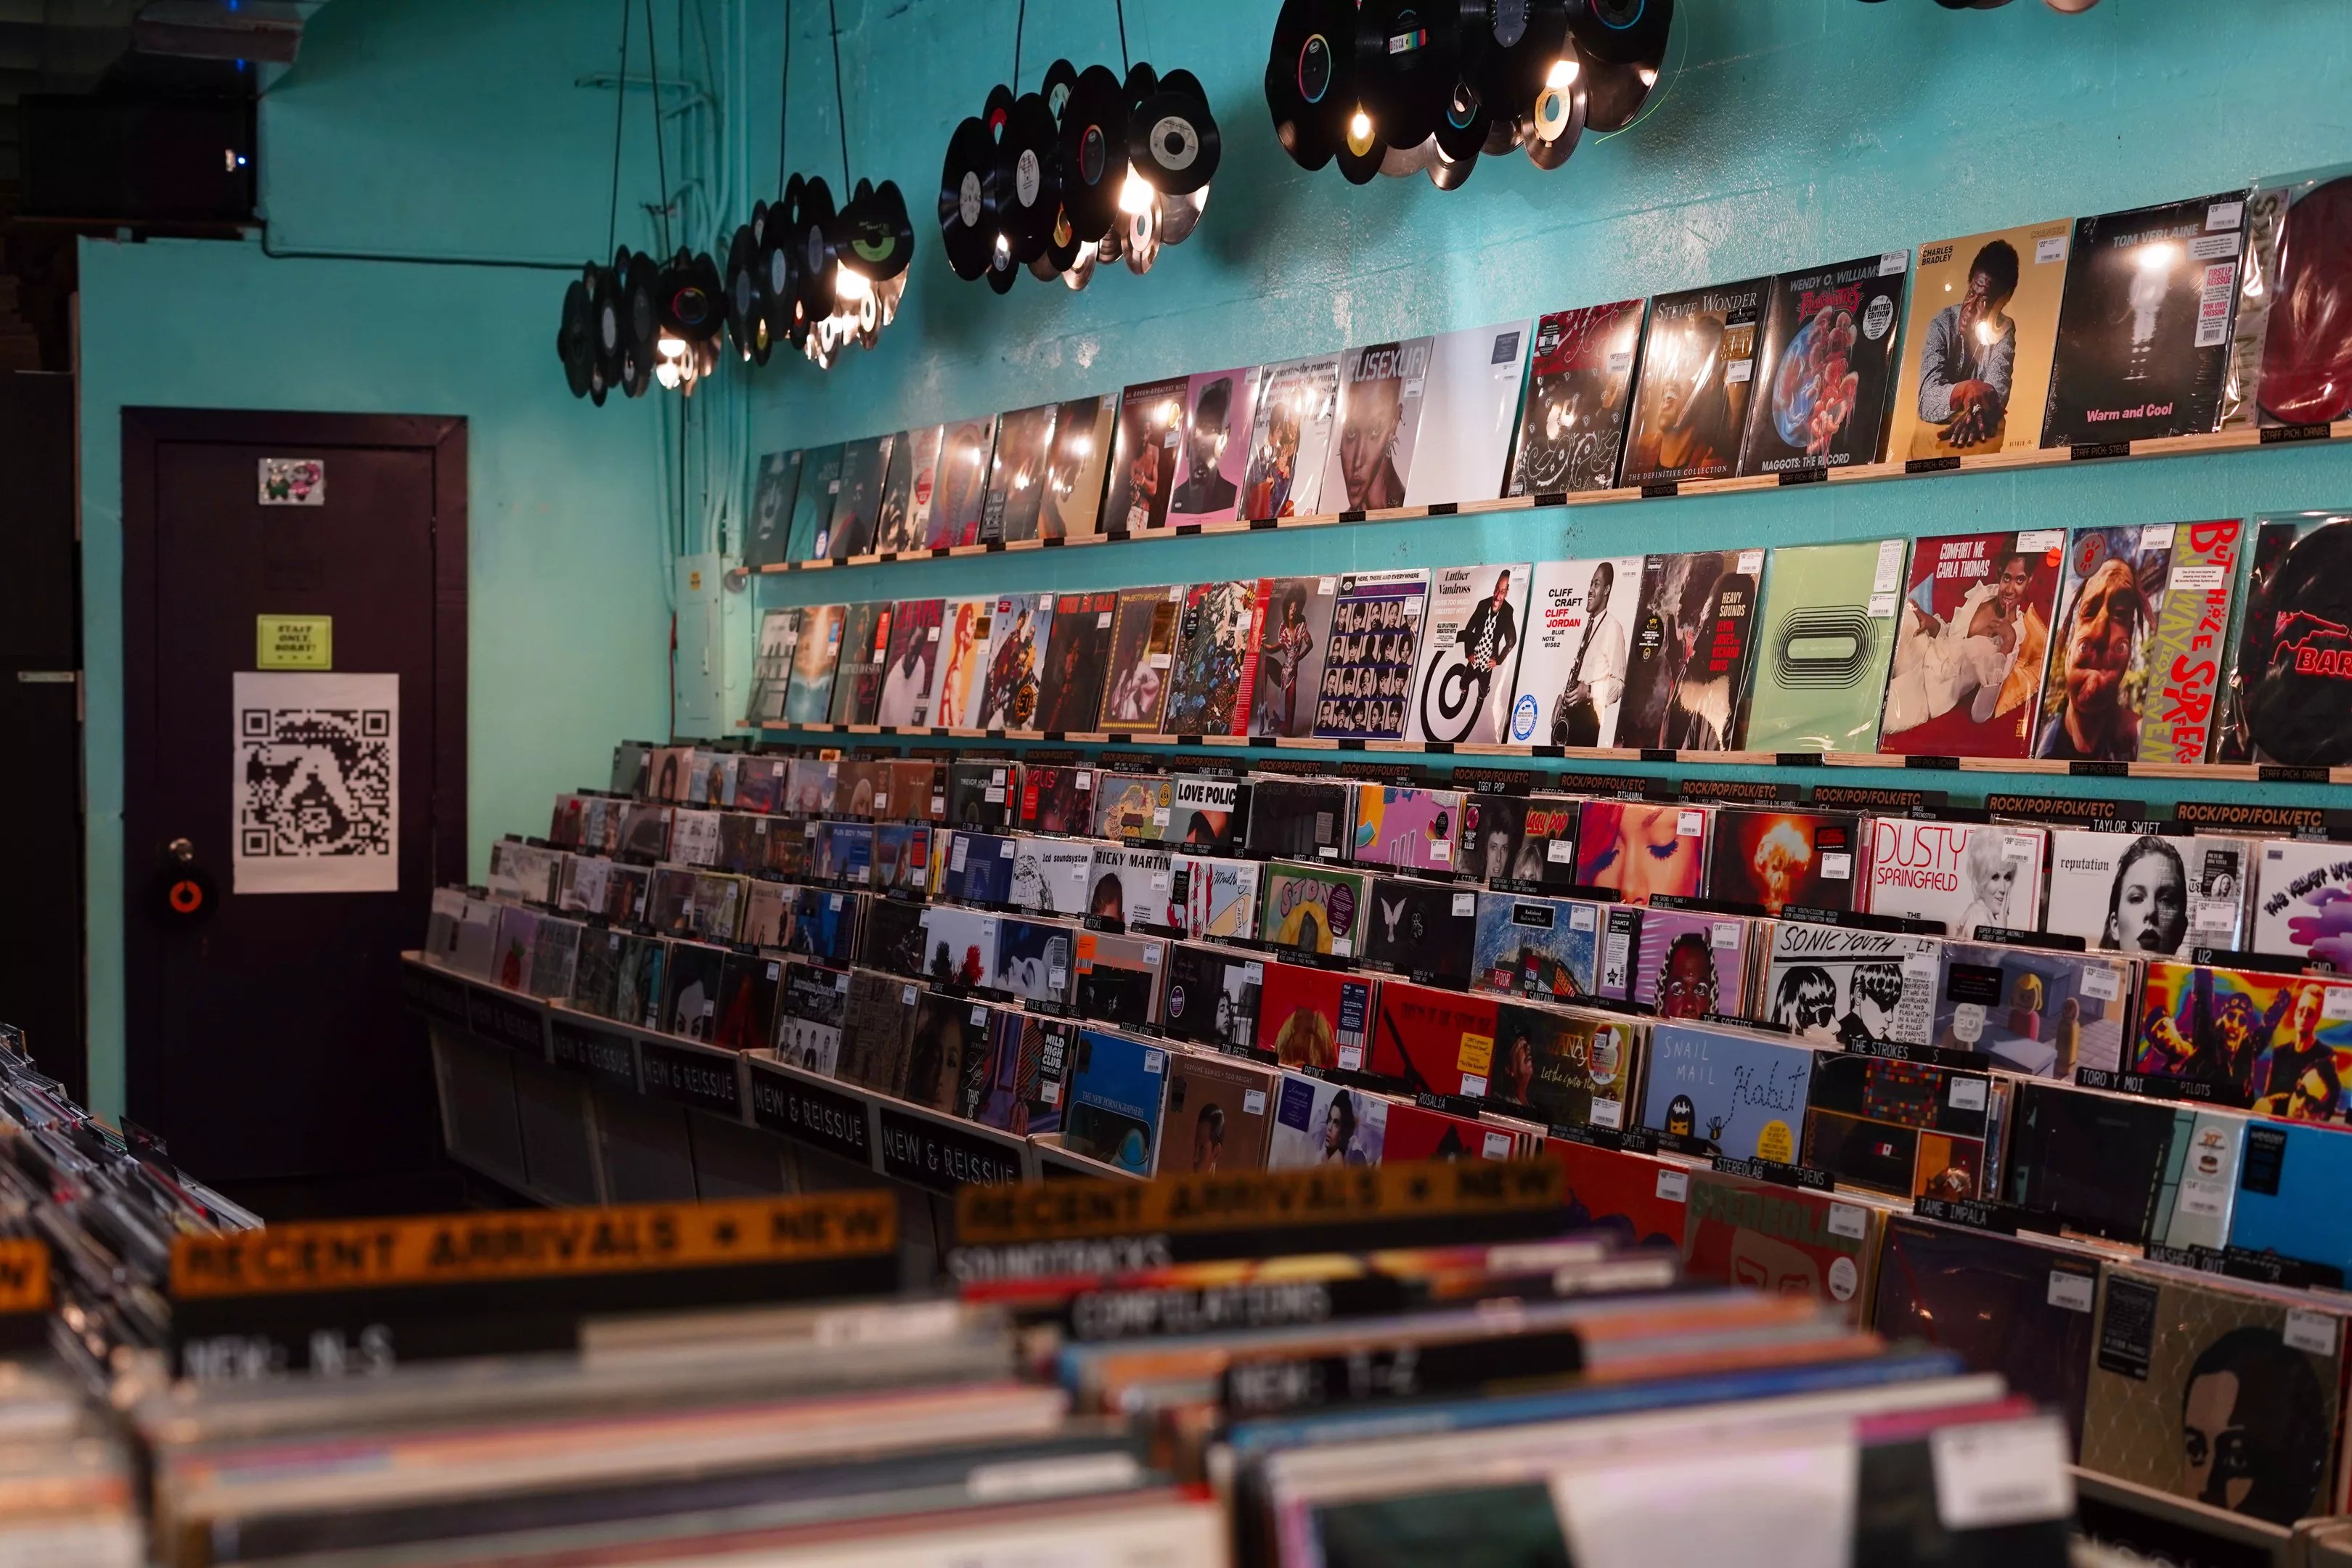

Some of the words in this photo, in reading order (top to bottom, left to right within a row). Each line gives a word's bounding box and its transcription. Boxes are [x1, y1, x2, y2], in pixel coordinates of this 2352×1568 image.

[1390, 38, 1405, 52] DECCA
[2113, 234, 2139, 248] TOM
[1923, 245, 1953, 258] CHARLES
[1922, 253, 1953, 266] BRADLEY
[1790, 275, 1822, 292] WENDY
[1824, 275, 1833, 285] O.
[1837, 264, 1881, 283] WILLIAMS
[2208, 268, 2225, 279] FIRST
[2225, 266, 2233, 277] LP
[2207, 275, 2231, 287] REISSUE
[1657, 302, 1697, 322] STEVIE
[1702, 293, 1757, 314] WONDER
[1867, 310, 1890, 319] EDITION
[1869, 302, 1890, 312] LIMITED
[2203, 308, 2226, 318] PRESSING
[2086, 408, 2120, 422] Warm
[2122, 404, 2143, 420] and
[2146, 402, 2173, 417] Cool
[2262, 430, 2282, 441] STAFF
[2283, 429, 2301, 438] PICK:
[2303, 426, 2329, 437] DANIEL
[2073, 448, 2089, 457] STAFF
[2091, 446, 2106, 456] PICK:
[2108, 444, 2128, 454] STEVE
[1762, 457, 1801, 472] MAGGOTS:
[1802, 456, 1816, 467] THE
[1906, 462, 1922, 473] STAFF
[1938, 457, 1959, 468] ROHAN
[1643, 469, 1681, 480] DEFINITIVE
[1683, 465, 1728, 477] COLLECTION
[1940, 542, 1972, 560] COMFORT
[1973, 542, 1986, 558] ME
[1445, 570, 1470, 581] Luther
[1936, 561, 1959, 579] CARLA
[1960, 560, 1990, 577] THOMAS
[1439, 582, 1471, 595] Vandross
[1548, 588, 1573, 597] CLIFF
[1555, 598, 1583, 608] CRAFT
[1722, 592, 1742, 604] HEAVY
[1545, 608, 1569, 618] CLIFF
[1719, 605, 1746, 617] SOUNDS
[1547, 618, 1580, 628] JORDAN
[1716, 621, 1735, 632] ELVIN
[1713, 633, 1734, 645] JONES
[1712, 647, 1740, 658] RICHARD
[1710, 660, 1729, 671] DAVIS
[1175, 756, 1231, 767] ROCK/POP/FOLK/ETC
[1259, 761, 1320, 772] ROCK/POP/FOLK/ETC
[1342, 763, 1410, 776] ROCK/POP/FOLK/ETC
[1453, 768, 1530, 783] ROCK/POP/FOLK/ETC
[2107, 766, 2127, 775] STEVE
[2261, 769, 2279, 777] STAFF
[2302, 770, 2329, 780] DANIEL
[1477, 781, 1491, 792] IGGY
[1493, 782, 1505, 793] POP
[1561, 775, 1646, 791] ROCK/POP/FOLK/ETC
[1682, 782, 1776, 799] ROCK/POP/FOLK/ETC
[1178, 783, 1204, 801] LOVE
[1617, 791, 1643, 801] RIHANNA
[1815, 788, 1922, 806] ROCK/POP/FOLK/ETC
[1989, 796, 2115, 817] ROCK/POP/FOLK/ETC
[2178, 804, 2323, 826] ROCK/POP/FOLK/ETC
[2093, 820, 2128, 833] TAYLOR
[2131, 821, 2160, 834] SWIFT
[1877, 823, 1966, 871] DUSTY
[1042, 854, 1052, 862] lcd
[1053, 854, 1087, 864] soundsystem
[1095, 851, 1125, 867] RICKY
[1129, 854, 1171, 871] MARTIN
[2059, 857, 2110, 872] reputation
[1877, 867, 1959, 891] SPRINGFIELD
[1085, 918, 1101, 929] MITSKI
[1781, 926, 1842, 951] SONIC
[1839, 932, 1896, 952] YOUTH
[2197, 949, 2212, 964] U2
[1495, 971, 1510, 987] POOR
[931, 982, 944, 992] LORDE
[1026, 1001, 1040, 1010] KYLIE
[1042, 1003, 1060, 1015] MINOGUE
[1045, 1034, 1065, 1048] MILD
[1663, 1035, 1710, 1061] SNAIL
[1044, 1045, 1063, 1059] HIGH
[1222, 1044, 1231, 1054] TOM
[1233, 1047, 1249, 1058] PETTY
[1850, 1040, 1869, 1053] THE
[1872, 1043, 1908, 1060] STROKES
[1042, 1056, 1061, 1070] CLUB
[643, 1058, 668, 1087] NEW
[673, 1065, 681, 1088] &
[684, 1066, 735, 1101] REISSUE
[1185, 1063, 1203, 1074] PERFUME
[1205, 1068, 1220, 1078] GENIUS
[1225, 1071, 1235, 1080] TOO
[1236, 1074, 1254, 1084] BRIGHT
[1304, 1066, 1325, 1080] PRINCE
[1677, 1064, 1715, 1085] MAIL
[2083, 1069, 2105, 1087] TORO
[2112, 1076, 2120, 1087] Y
[2124, 1077, 2144, 1093] MOI
[967, 1089, 980, 1105] THIS
[1082, 1091, 1092, 1101] THE
[1091, 1093, 1103, 1104] NEW
[1103, 1098, 1144, 1118] PORNOGRAPHERS
[754, 1082, 783, 1117] NEW
[789, 1098, 799, 1122] &
[804, 1101, 863, 1147] REISSUE
[968, 1104, 974, 1118] IS
[1620, 1133, 1646, 1150] SMITH
[883, 1127, 920, 1167] NEW
[927, 1139, 939, 1170] &
[944, 1146, 1015, 1188] REISSUE
[1716, 1158, 1763, 1180] STEREOLAB
[1168, 1170, 1382, 1221] ARRIVALS
[1920, 1199, 1946, 1217] TAME
[1950, 1204, 1987, 1225] IMPALA
[184, 1229, 404, 1286] RECENT
[426, 1209, 680, 1273] ARRIVALS
[769, 1198, 891, 1247] NEW
[949, 1236, 1173, 1283] SOUNDTRACKS
[2150, 1247, 2195, 1268] WASHED
[2202, 1257, 2224, 1275] OUT
[1072, 1283, 1332, 1339] COMPILATIONS
